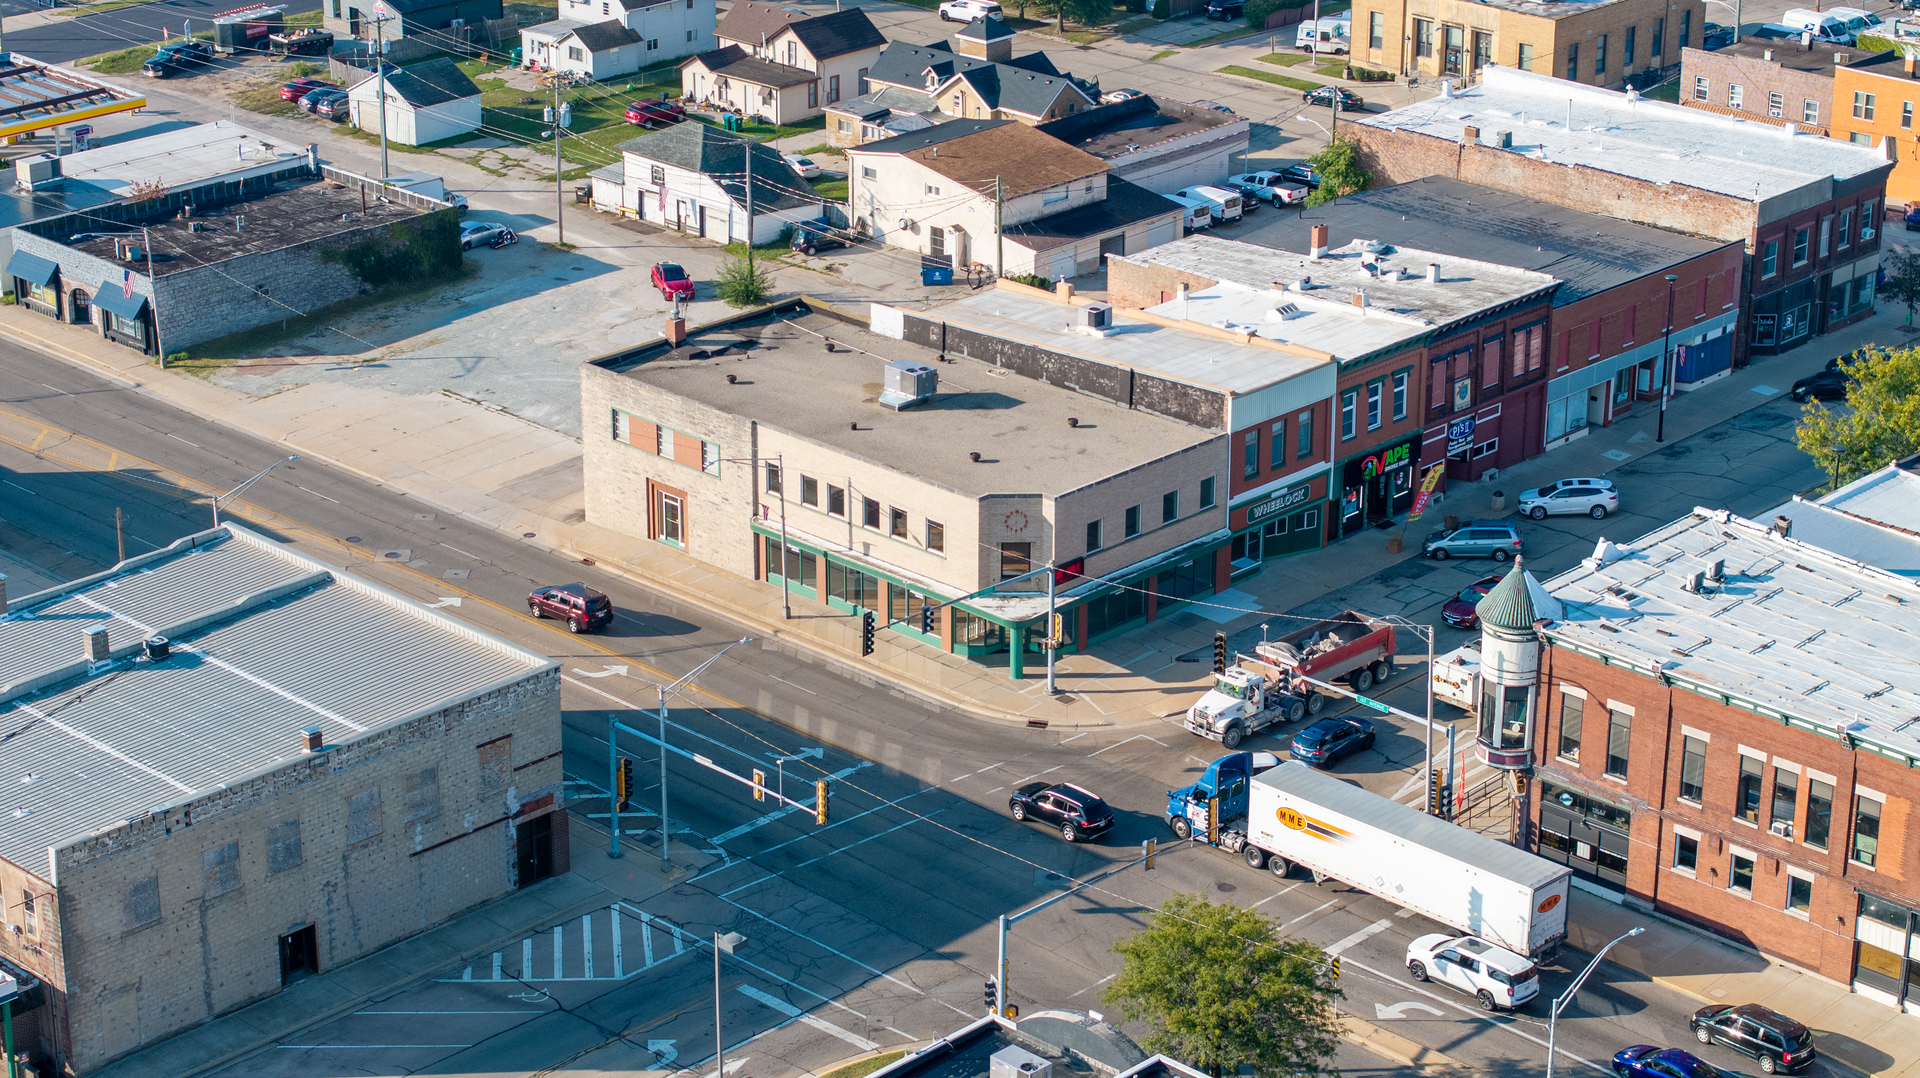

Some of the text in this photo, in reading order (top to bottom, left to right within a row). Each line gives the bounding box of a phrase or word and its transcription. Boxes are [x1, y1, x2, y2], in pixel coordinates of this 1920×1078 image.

[1384, 458, 1410, 473] SMOKE SHOP
[1253, 488, 1305, 518] WHEELOCK
[1279, 810, 1303, 827] MME
[1540, 896, 1559, 911] MME
